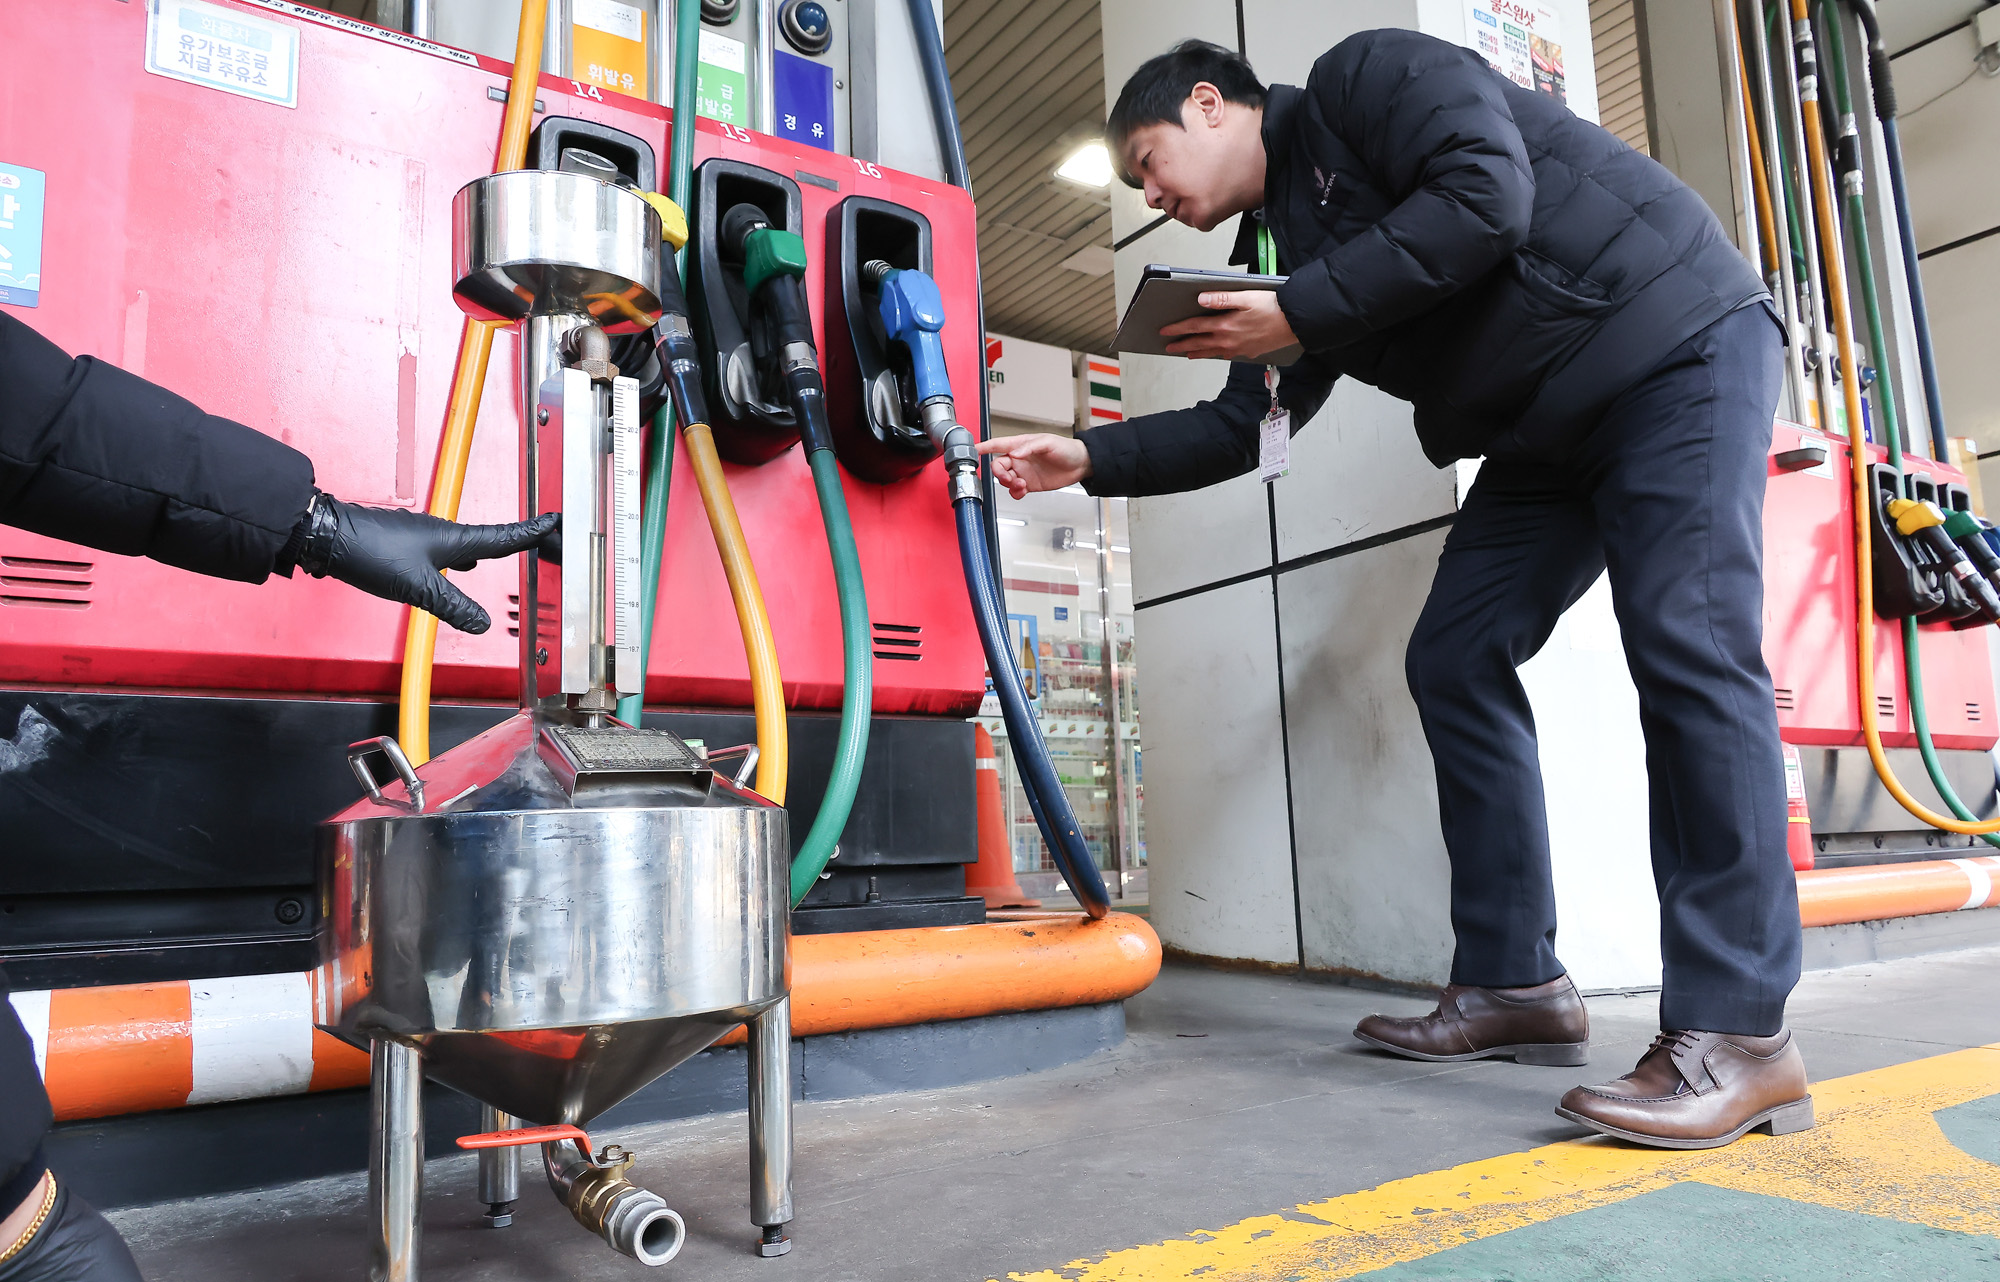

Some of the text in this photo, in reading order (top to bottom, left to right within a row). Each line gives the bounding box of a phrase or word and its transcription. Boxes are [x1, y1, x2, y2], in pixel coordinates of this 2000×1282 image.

[201, 16, 251, 44] 화물차
[178, 34, 269, 71] 유가보조금
[178, 50, 268, 87] 지급 주유소
[587, 62, 636, 91] 휘발유
[1509, 70, 1531, 88] 21,000
[570, 80, 604, 102] 14
[719, 122, 752, 144] 15
[852, 158, 883, 180] 16
[627, 383, 639, 392] 20.3
[627, 426, 639, 434] 20.2
[627, 469, 639, 477] 20.1
[627, 513, 640, 521] 20.0
[628, 556, 640, 564] 19.9
[628, 600, 640, 609] 19.8
[628, 645, 640, 653] 19.7
